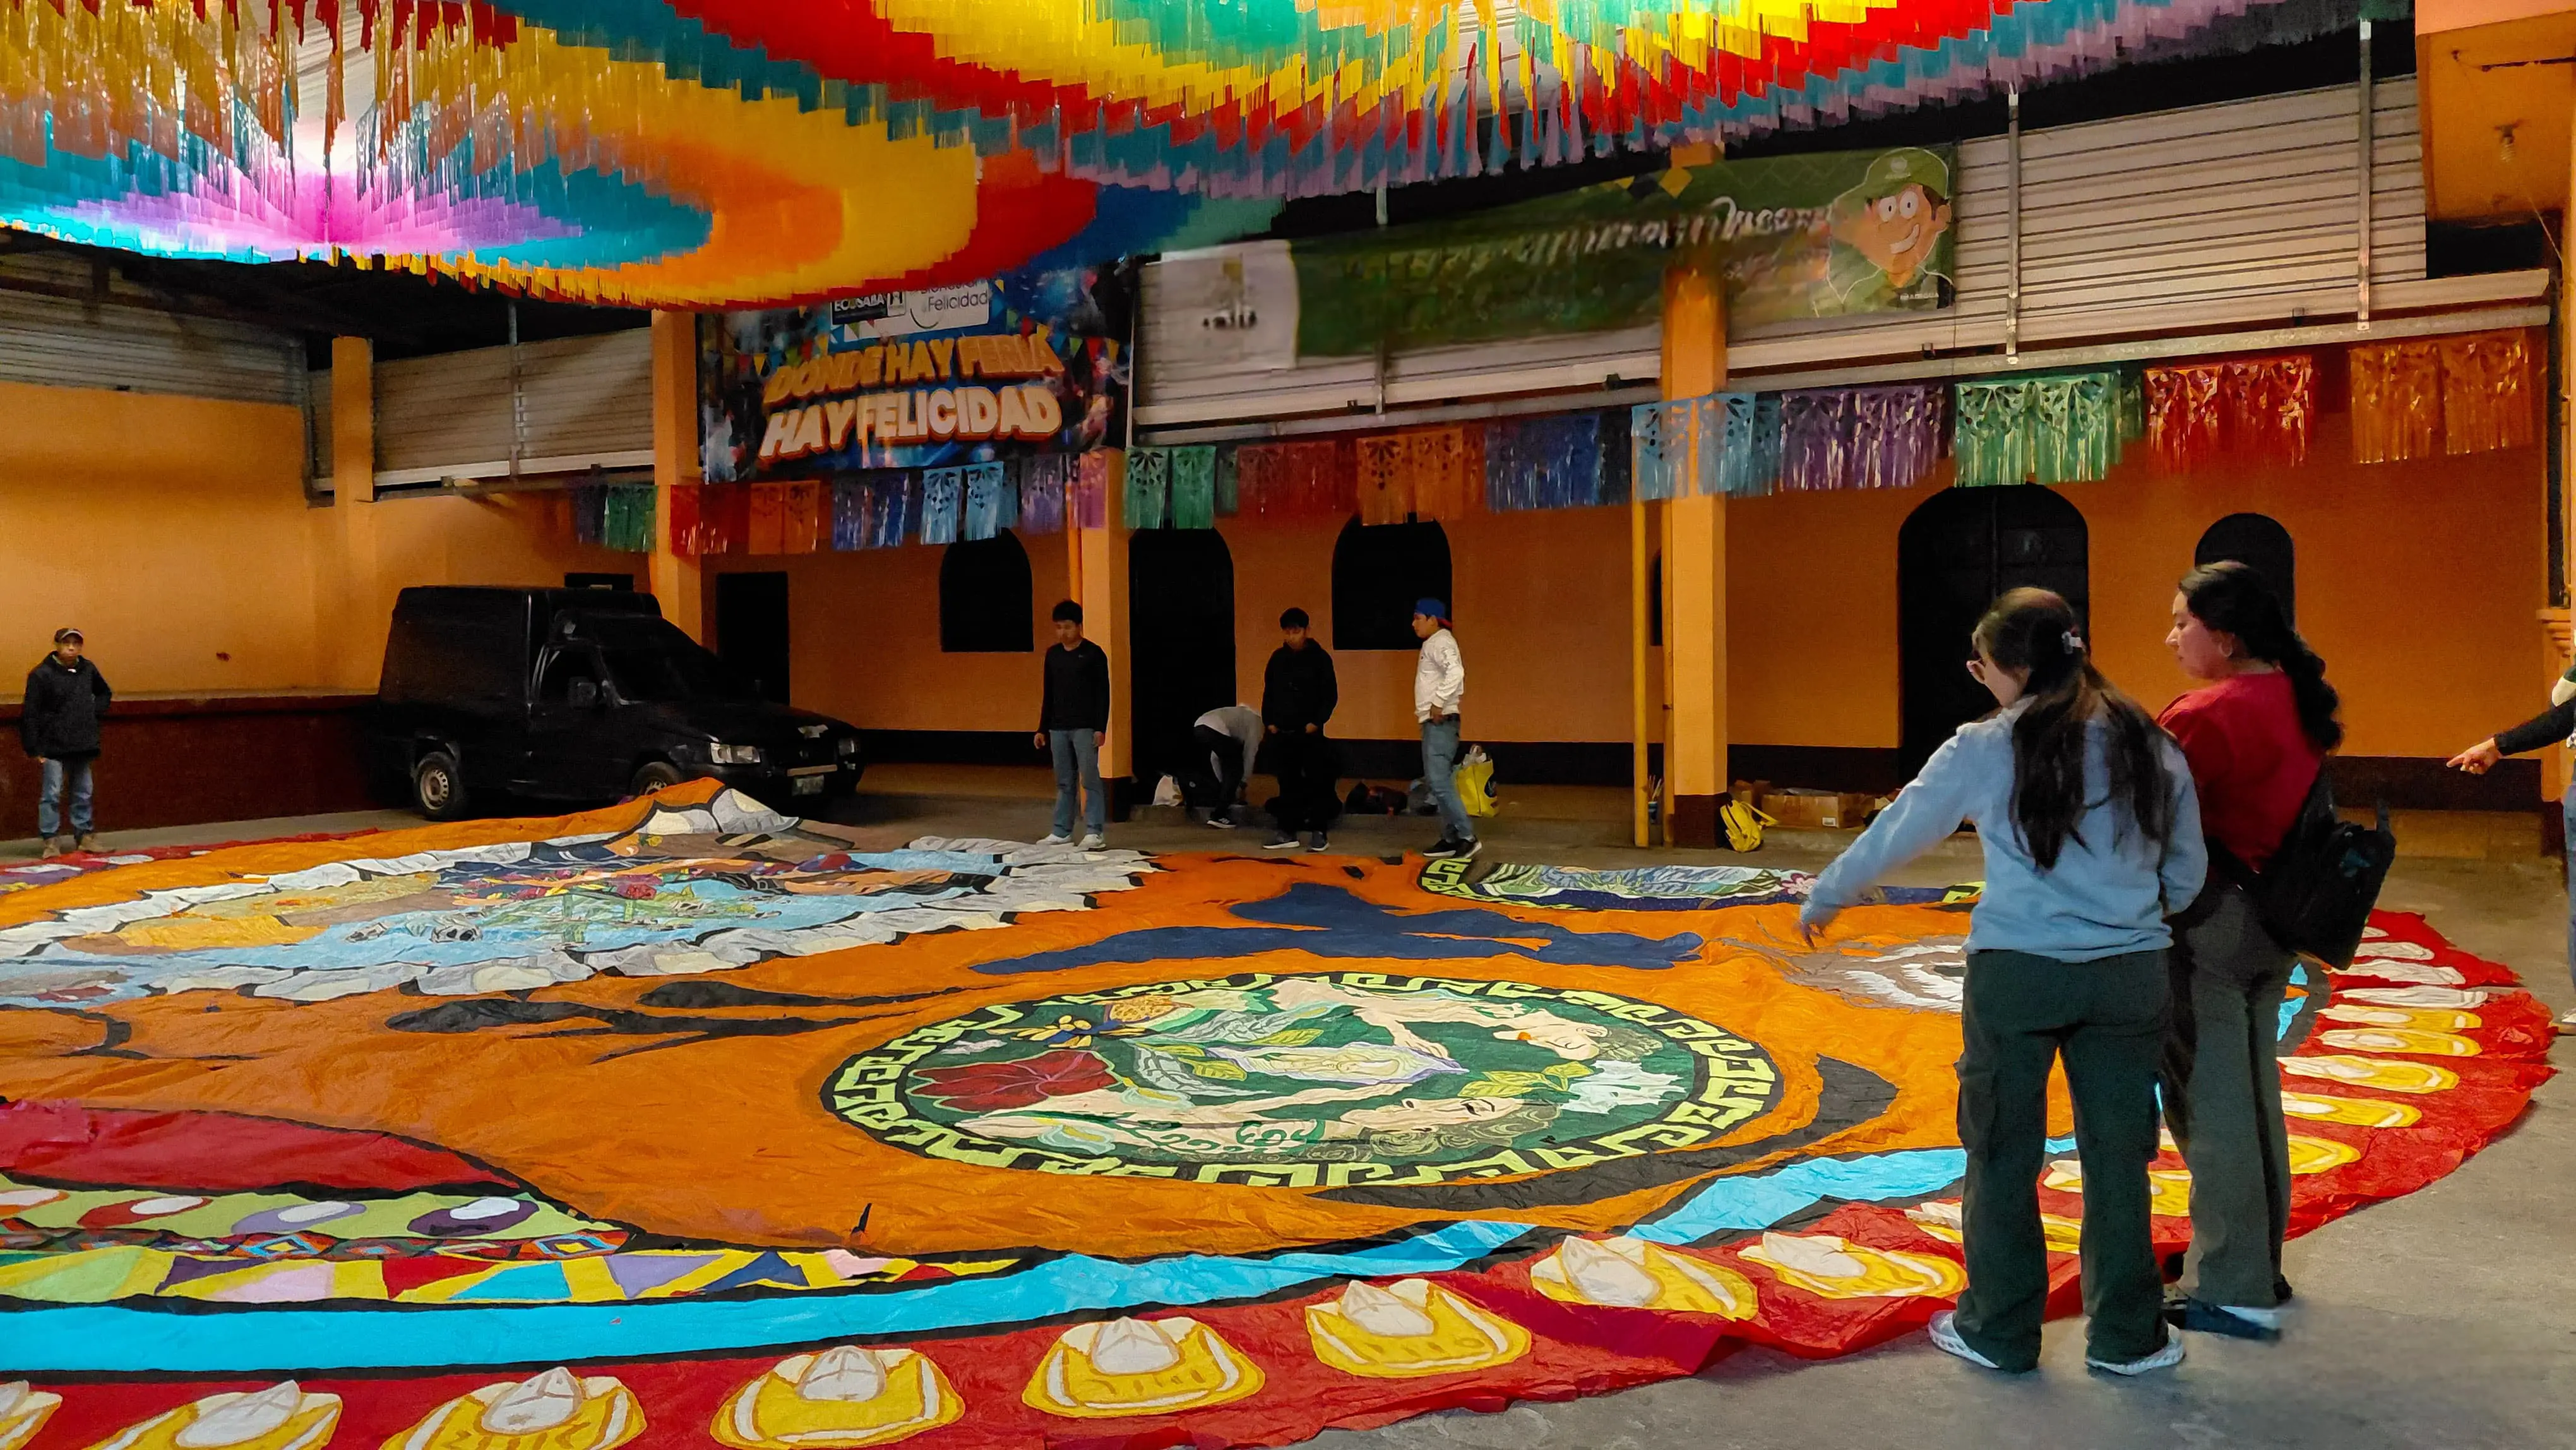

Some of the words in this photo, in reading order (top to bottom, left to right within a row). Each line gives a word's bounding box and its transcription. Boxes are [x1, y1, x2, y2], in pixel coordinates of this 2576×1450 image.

[928, 291, 987, 312] Felicidad
[885, 339, 954, 384] HAY
[759, 399, 856, 460] HAY
[856, 386, 1062, 443] FELICIDAD
